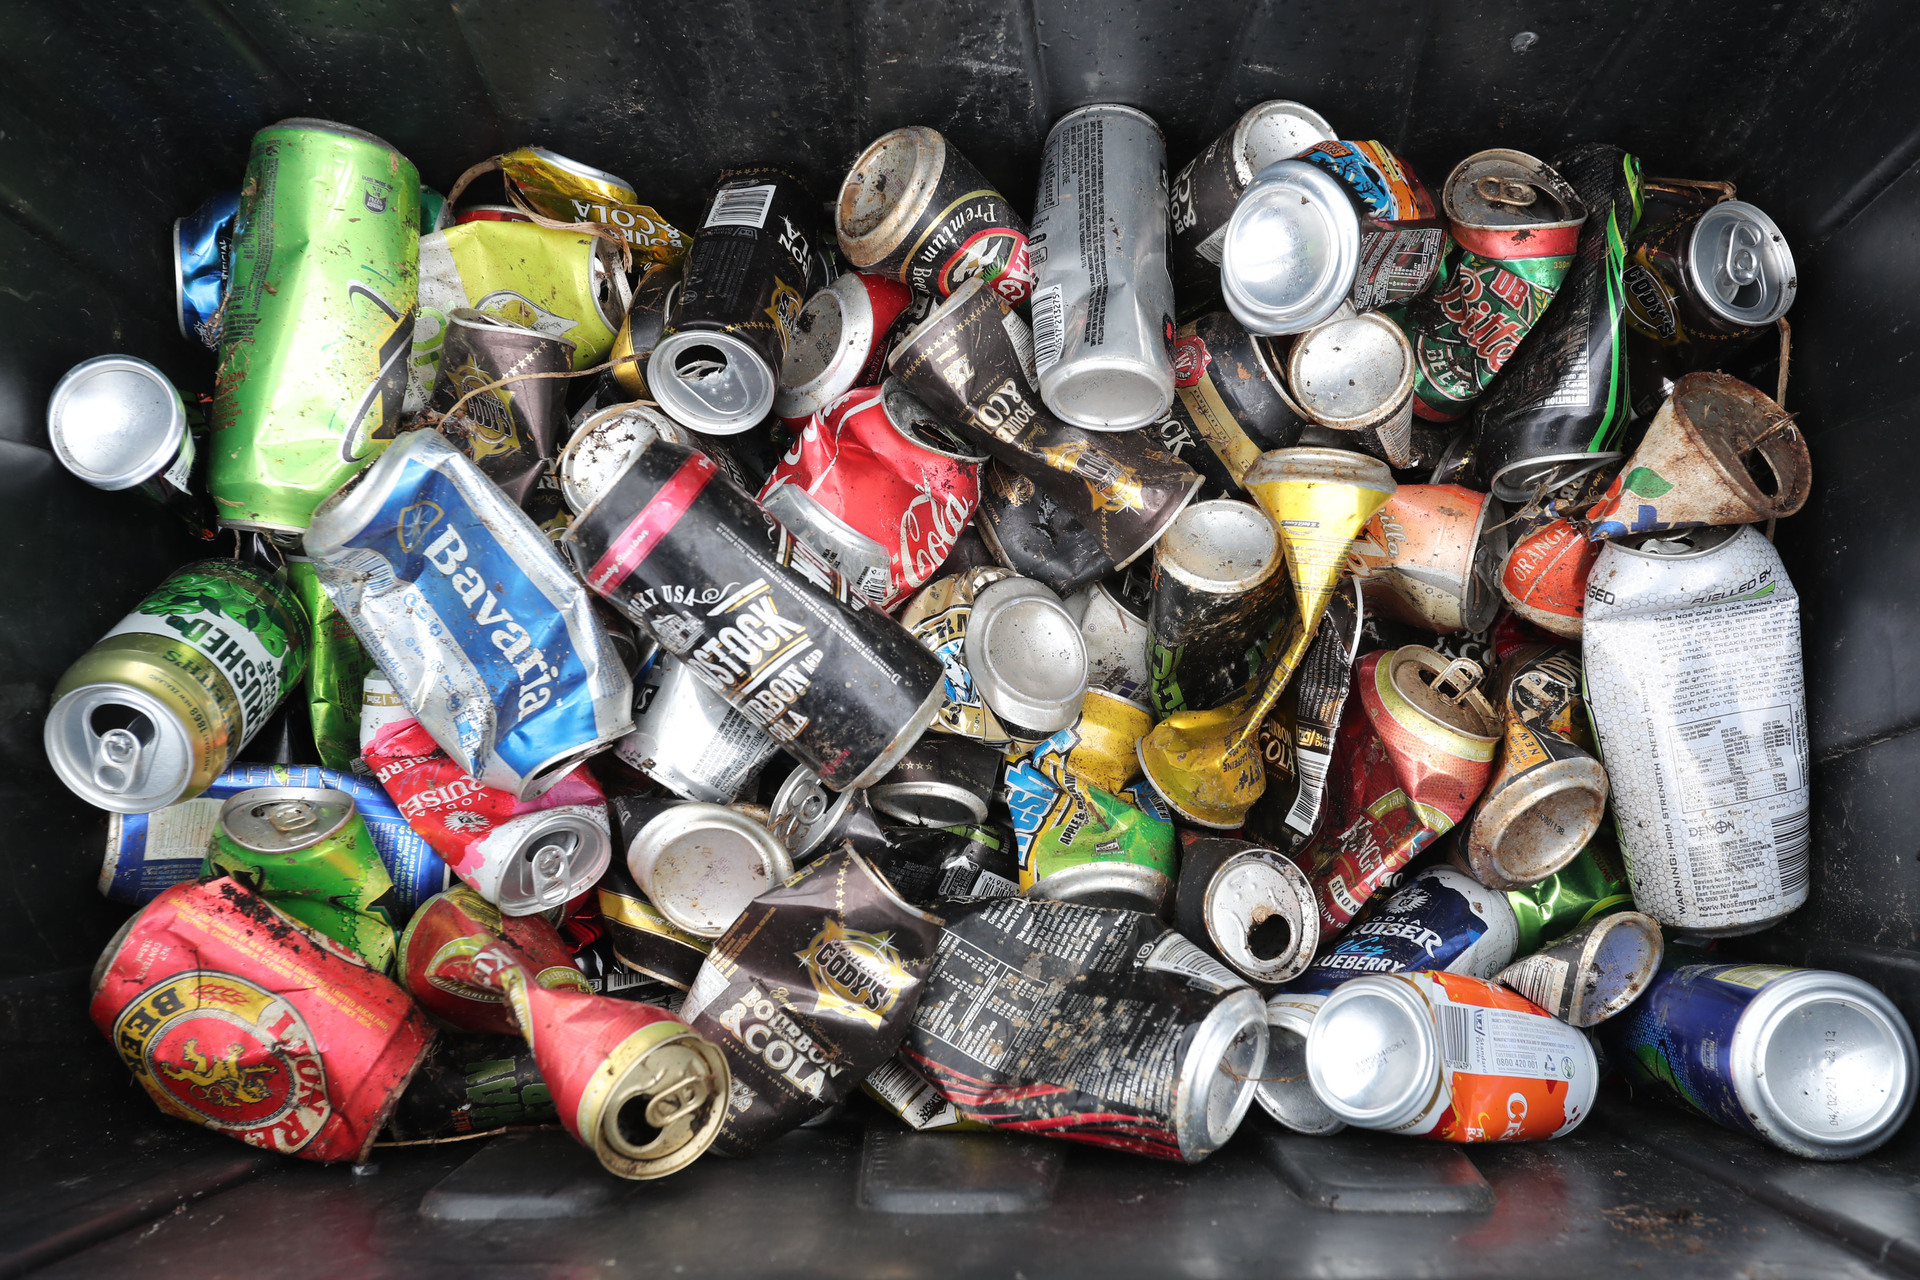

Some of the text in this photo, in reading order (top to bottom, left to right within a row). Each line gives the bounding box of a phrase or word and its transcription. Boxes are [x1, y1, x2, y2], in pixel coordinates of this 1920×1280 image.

[566, 197, 658, 236] COLA
[911, 203, 997, 294] Premium Beer
[1490, 269, 1531, 312] DB
[1434, 263, 1533, 376] Bitte
[1425, 346, 1471, 398] BEER
[900, 465, 975, 592] Cola
[1513, 523, 1570, 583] ORANGE
[661, 584, 698, 607] USA
[1691, 566, 1772, 605] FUELLED BY
[423, 523, 559, 722] Bavaria
[1653, 615, 1672, 623] THIS
[1674, 611, 1693, 620] NOS
[1695, 608, 1712, 617] CAN
[1724, 604, 1741, 612] LIKE
[1743, 599, 1773, 609] TAKING
[1726, 606, 1768, 618] LOWERING
[1734, 613, 1767, 624] RIPPING
[1772, 616, 1792, 626] WITH
[1689, 688, 1710, 697] CAME
[1711, 684, 1733, 693] HERE
[190, 706, 210, 732] 1868
[741, 730, 765, 762] CAFFEINE
[398, 774, 486, 817] RUISE
[415, 793, 489, 818] VODKA
[1058, 814, 1080, 847] APPLE
[1645, 715, 1687, 916] WARNING: HIGH STRENGTH ENERGY
[394, 834, 404, 851] your
[404, 853, 418, 888] steal your
[1327, 877, 1361, 917] STRON
[1697, 893, 1775, 912] www.NosEnergy.co.nz
[986, 907, 1002, 926] Cross
[1002, 917, 1017, 935] down
[1030, 914, 1054, 949] only your
[1062, 907, 1076, 923] some
[1083, 911, 1102, 937] spinning
[1367, 915, 1422, 926] ODKA
[1014, 928, 1027, 942] The
[1058, 920, 1077, 946] cool with
[1059, 912, 1091, 960] blend flavours,
[133, 938, 163, 983] CONTENTS
[810, 937, 893, 1014] CODY'S
[736, 1016, 833, 1104] COLA
[1479, 1036, 1489, 1073] Standard
[1495, 1057, 1539, 1069] 0800 420 001
[241, 1116, 312, 1150] RE
